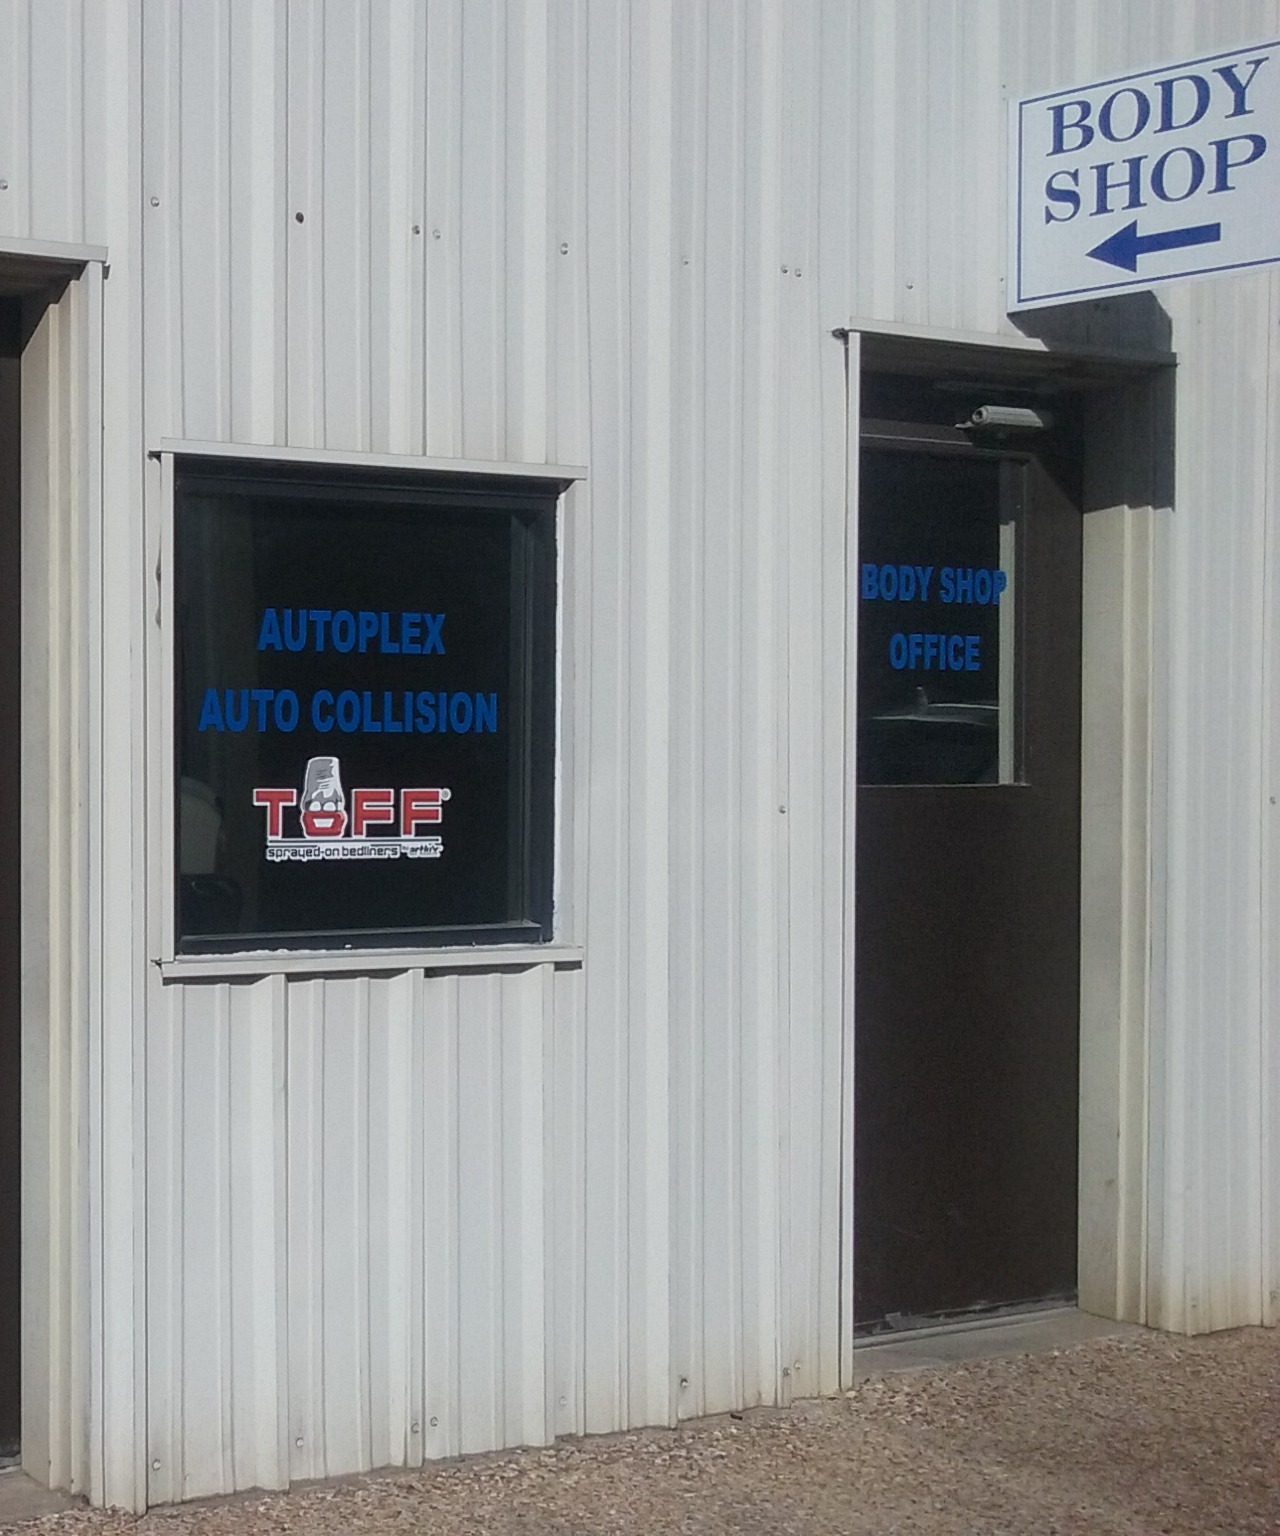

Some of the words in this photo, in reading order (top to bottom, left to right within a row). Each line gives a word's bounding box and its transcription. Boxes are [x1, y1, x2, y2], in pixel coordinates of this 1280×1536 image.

[1046, 57, 1270, 157] BODY
[1045, 134, 1267, 225] SHOP
[861, 563, 934, 602] BODY
[940, 566, 1008, 606] SHOP
[257, 608, 446, 655] AUTOPLEX
[888, 632, 982, 672] OFFICE
[198, 687, 300, 732] AUTO
[310, 689, 499, 734] COLLISION
[342, 844, 398, 858] bedliners
